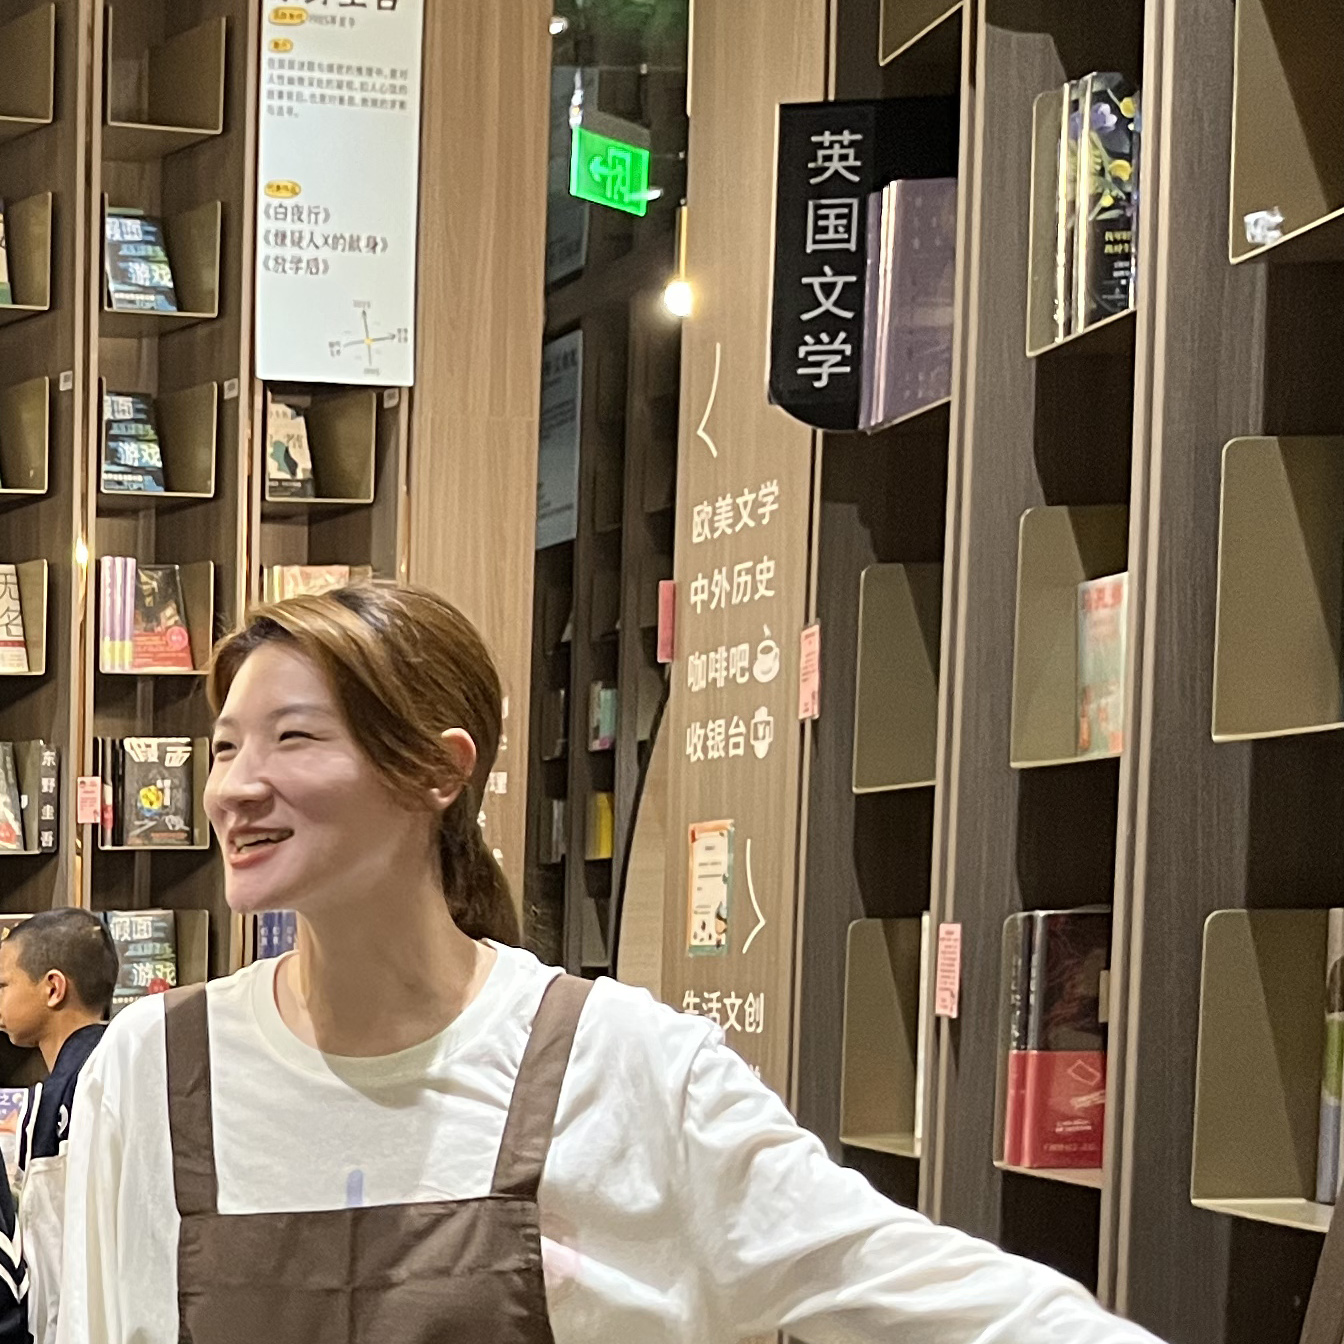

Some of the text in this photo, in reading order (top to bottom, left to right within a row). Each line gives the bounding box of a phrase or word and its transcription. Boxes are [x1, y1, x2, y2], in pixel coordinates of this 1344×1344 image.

[263, 203, 330, 225] 《白夜行》
[796, 129, 864, 388] 英国文学
[691, 479, 780, 545] 欧美文学
[689, 556, 776, 614] 中外历史
[687, 643, 749, 692] 咖啡吧
[686, 715, 748, 763] 收银台
[40, 749, 57, 848] 东野圭吾
[682, 990, 764, 1034] 生活文创
